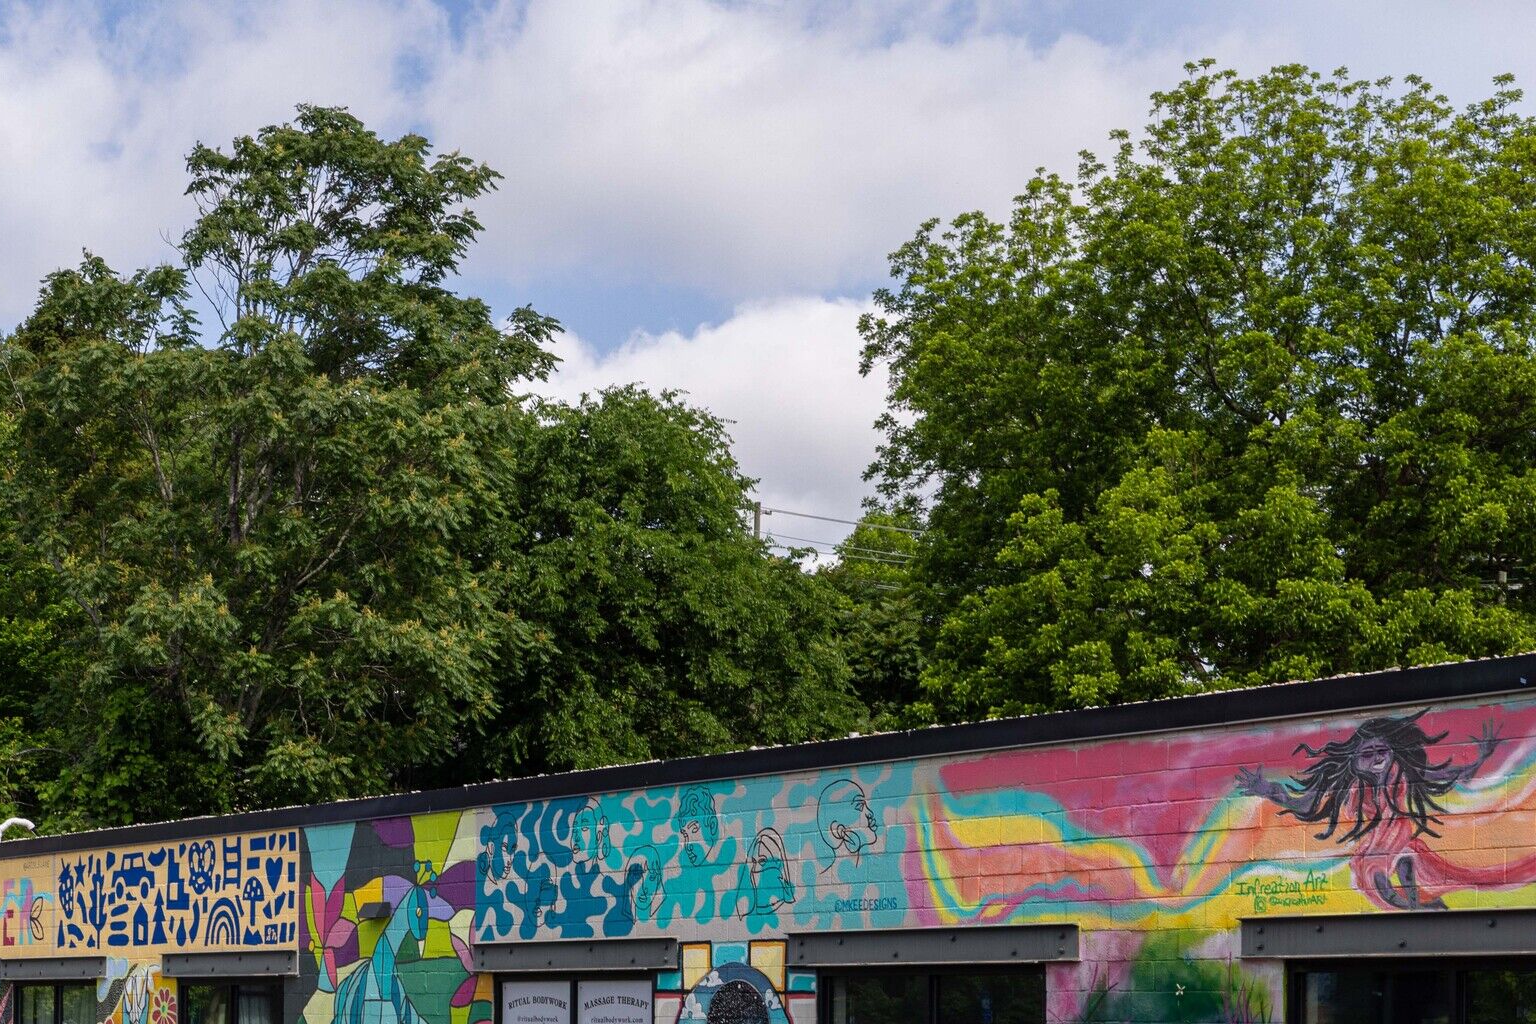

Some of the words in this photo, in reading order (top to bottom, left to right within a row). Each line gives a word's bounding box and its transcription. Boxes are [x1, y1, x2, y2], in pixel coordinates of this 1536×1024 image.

[508, 996, 530, 1010] RITUAL
[532, 995, 567, 1010] BODYWORK
[584, 996, 614, 1010] MASSAGE
[617, 996, 649, 1010] THERAPY
[591, 1016, 644, 1024] ritualbodywork.com
